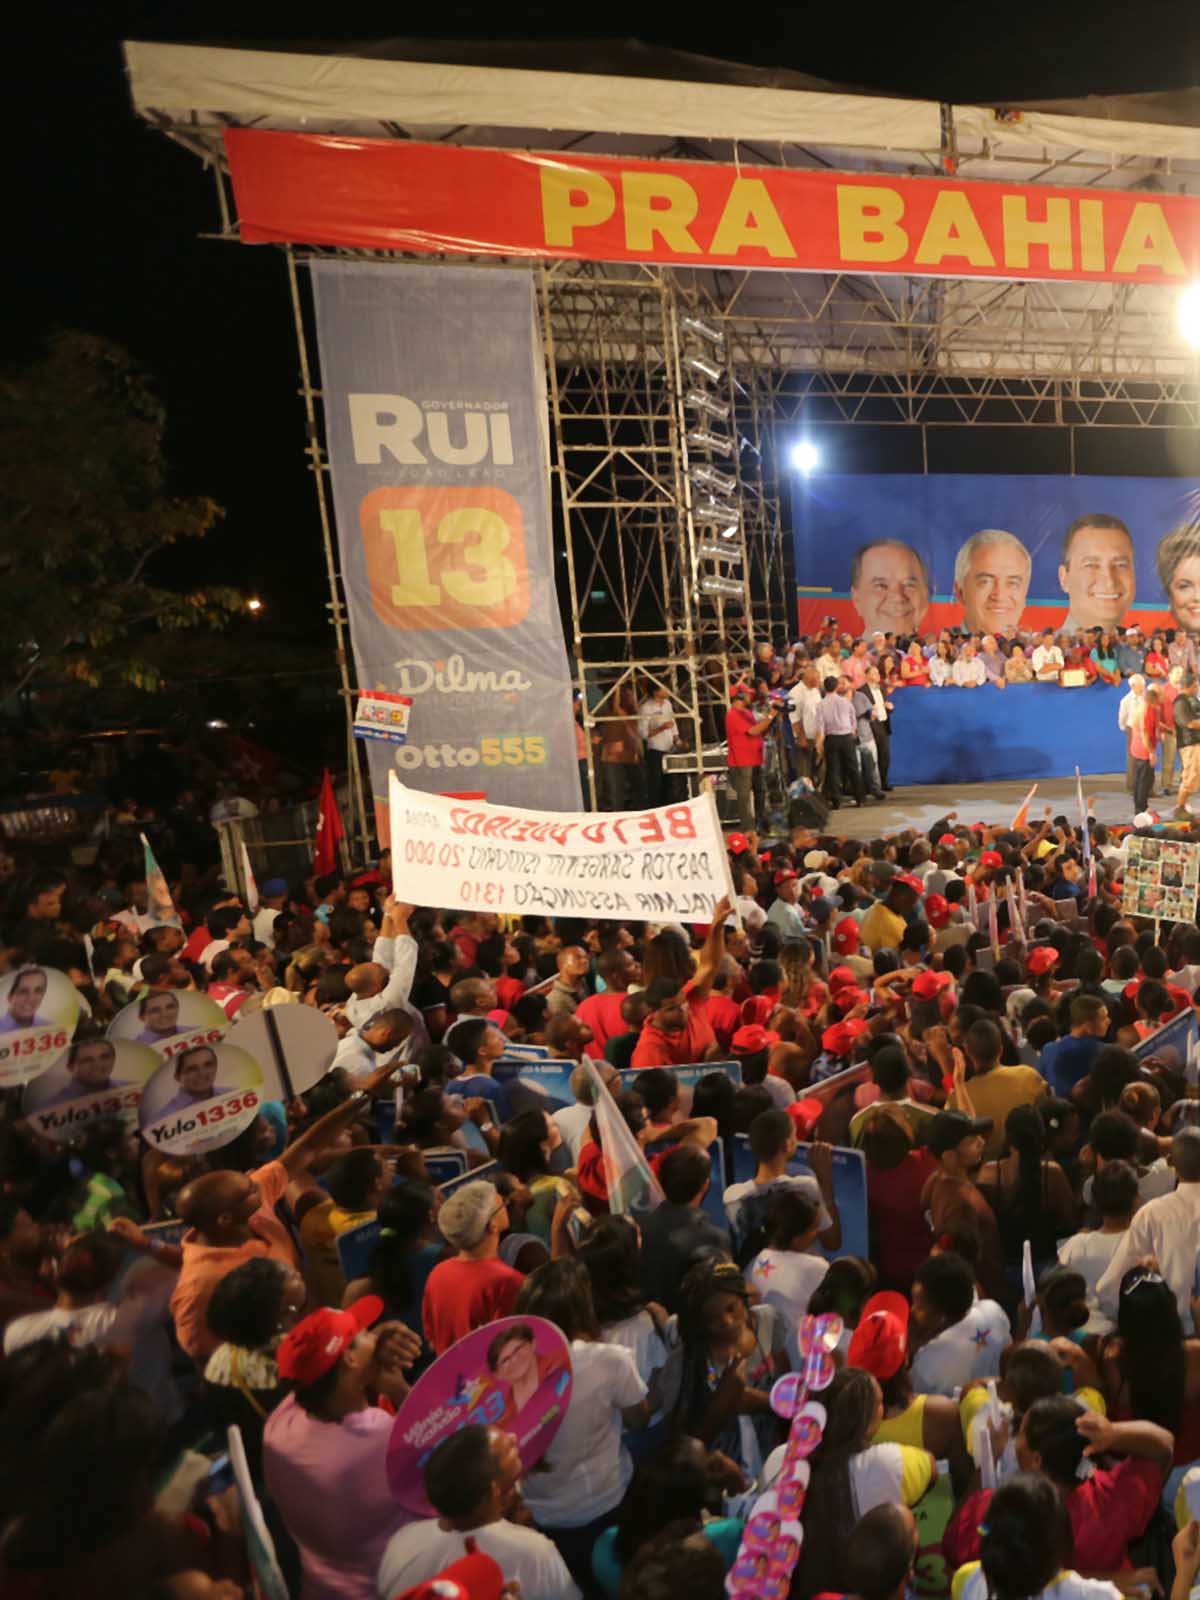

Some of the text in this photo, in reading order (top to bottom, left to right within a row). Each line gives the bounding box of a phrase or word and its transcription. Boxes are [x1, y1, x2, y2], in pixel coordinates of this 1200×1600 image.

[540, 166, 797, 259] PRA
[836, 184, 1187, 277] BAHIA
[379, 507, 518, 608] 13
[394, 655, 532, 694] Dilma
[37, 1091, 142, 1131] Yulo133
